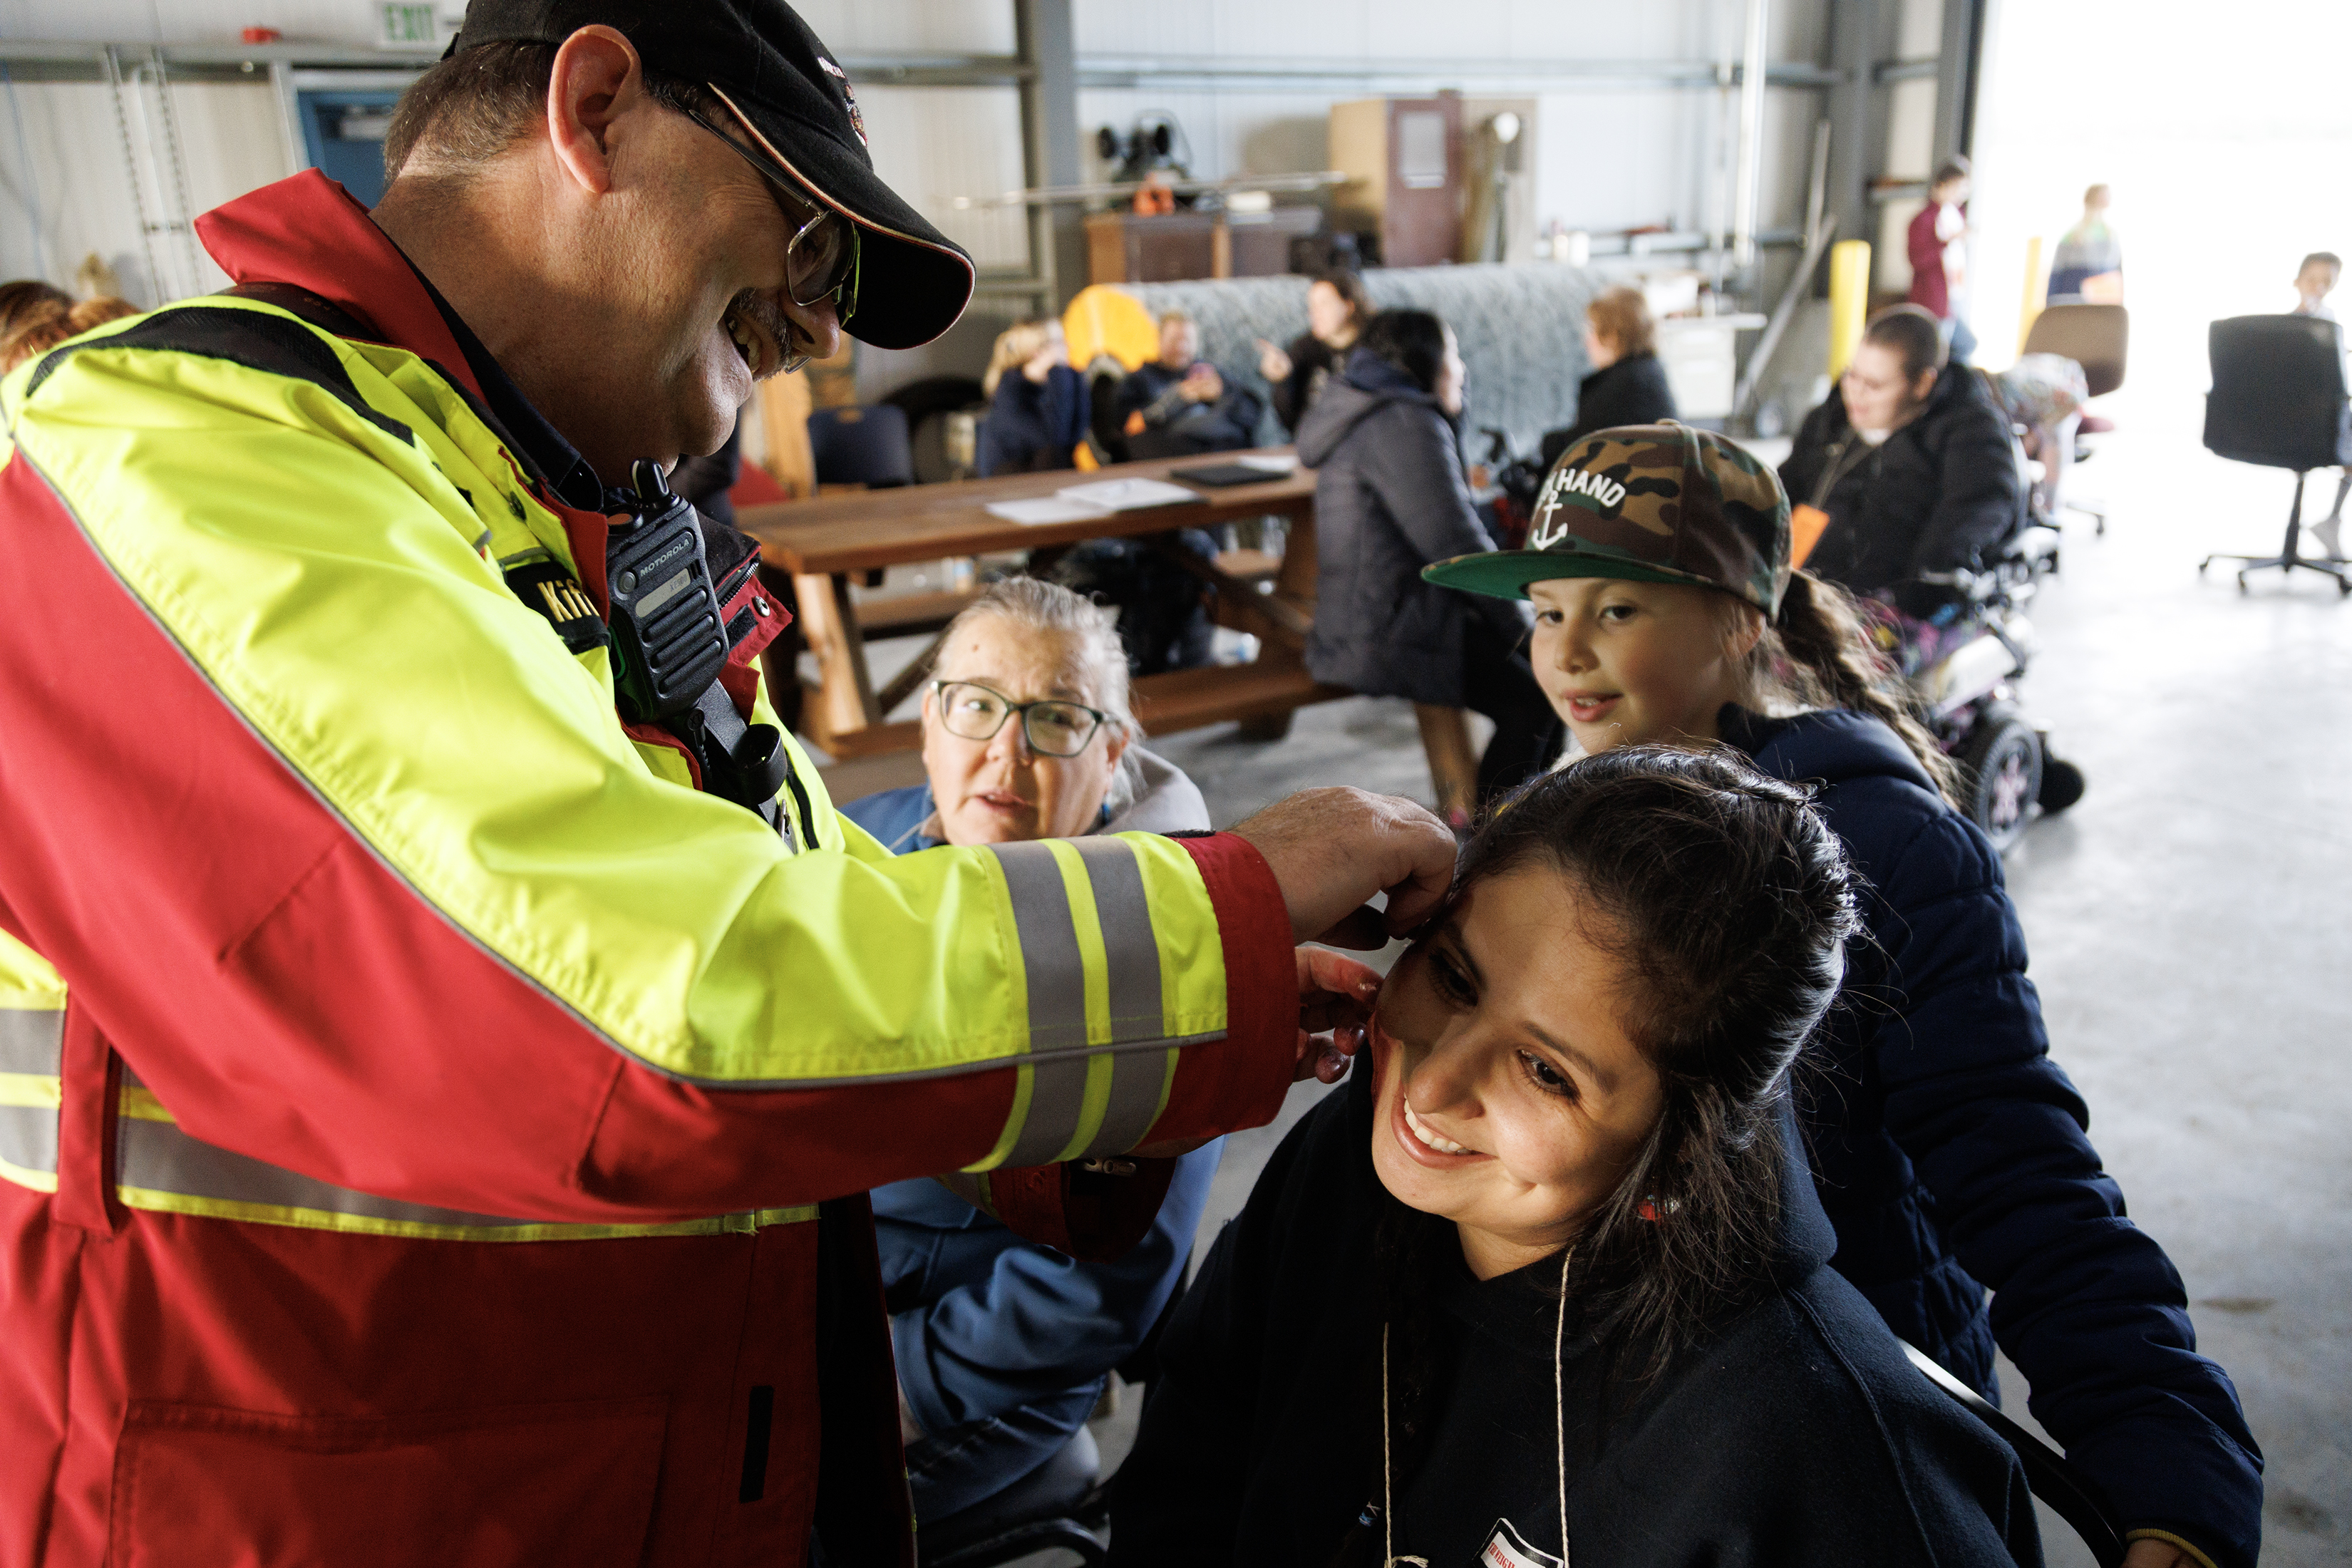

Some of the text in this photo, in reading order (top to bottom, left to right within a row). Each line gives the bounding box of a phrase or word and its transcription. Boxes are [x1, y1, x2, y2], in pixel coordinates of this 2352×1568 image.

[383, 5, 434, 41] EXIT
[1557, 468, 1626, 507] HAND
[640, 539, 690, 577] MOTOROLA
[1494, 1549, 1518, 1568] WEIGH
